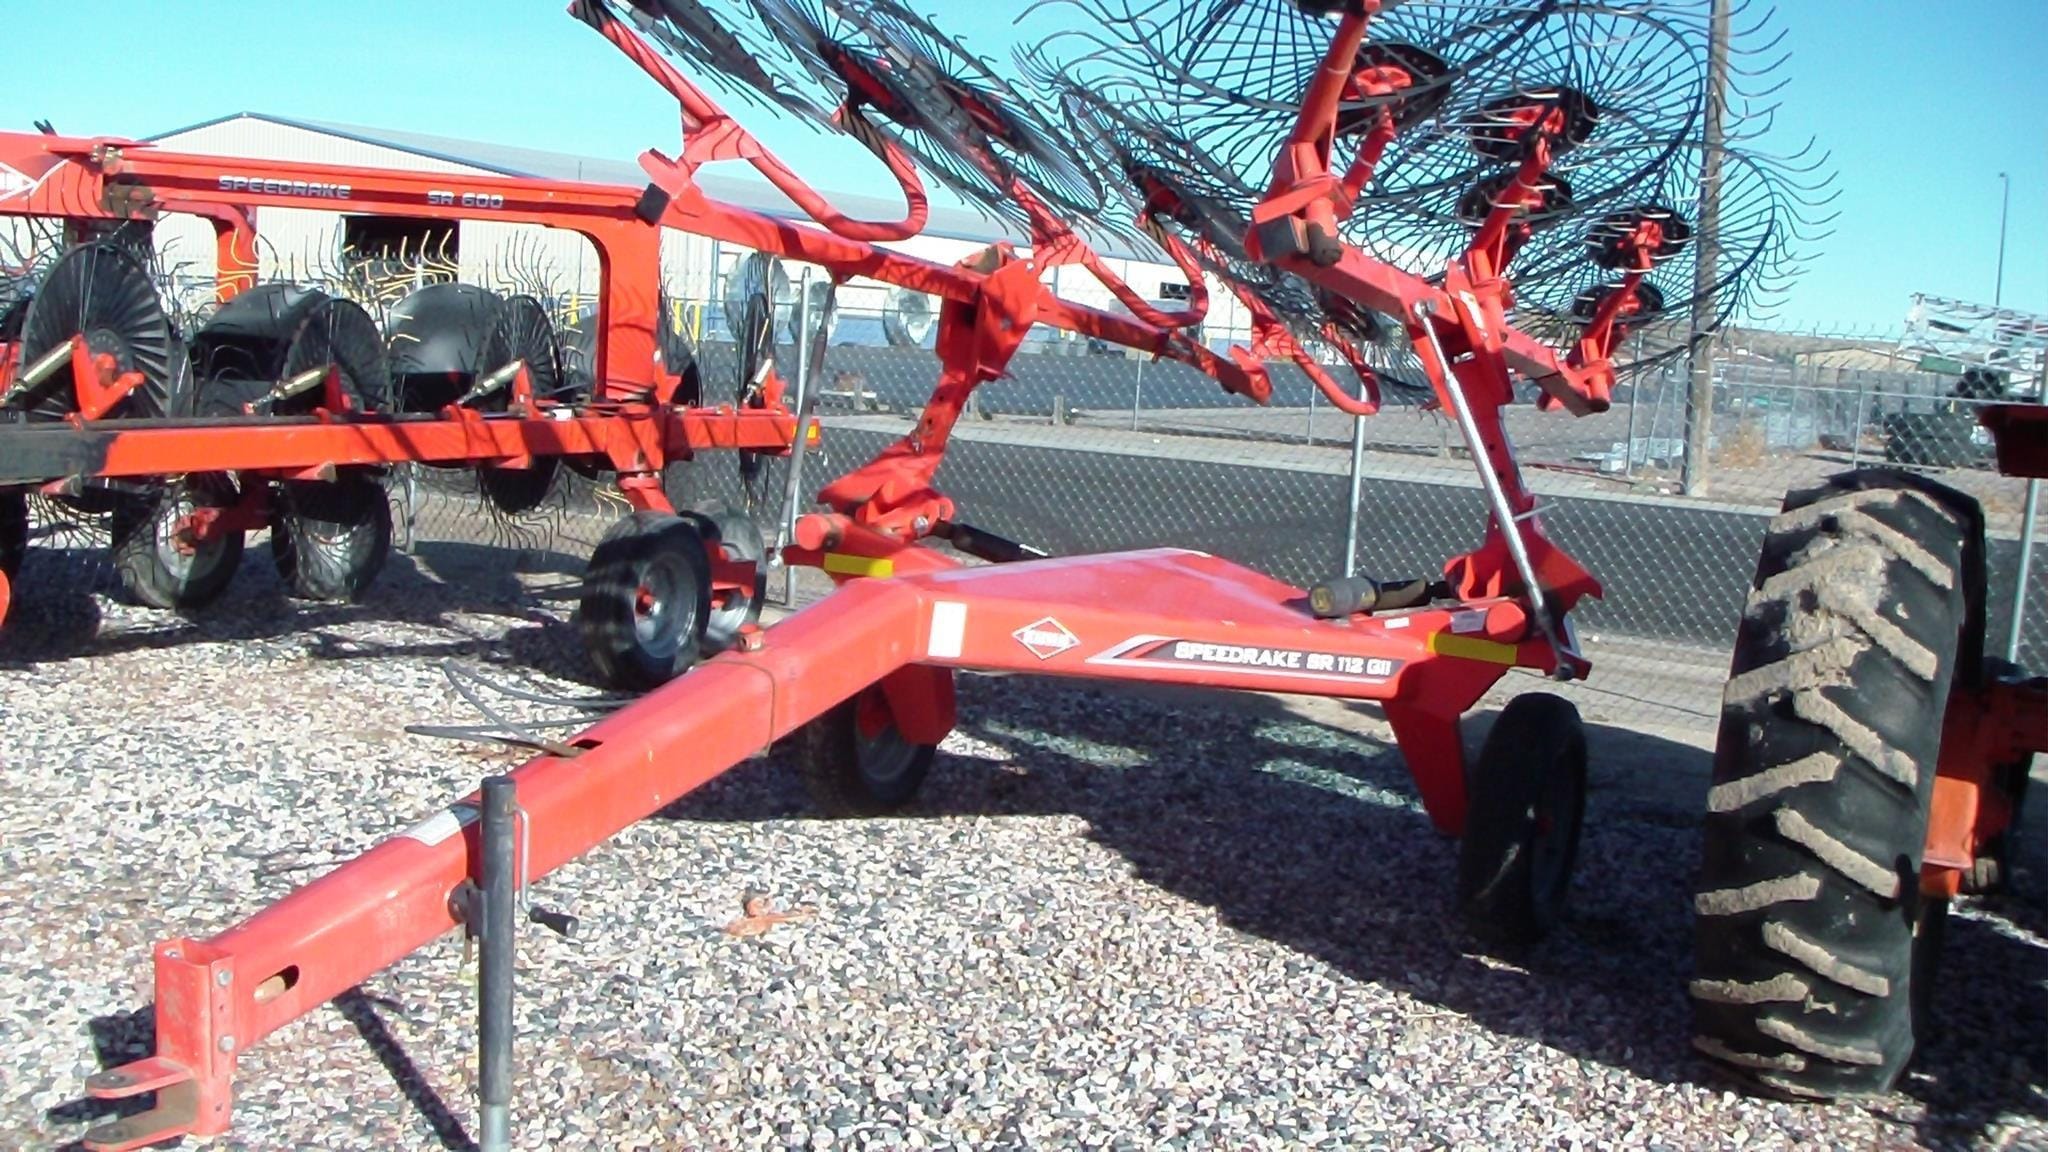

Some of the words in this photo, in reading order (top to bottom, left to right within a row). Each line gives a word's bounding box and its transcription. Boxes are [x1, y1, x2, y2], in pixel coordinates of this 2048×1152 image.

[219, 175, 351, 199] SPEEDRAKE
[427, 190, 454, 205] SR
[461, 192, 504, 209] 600
[1175, 641, 1302, 668] SPEEDRAKE
[1306, 653, 1334, 671] SR
[1338, 656, 1364, 674] 112
